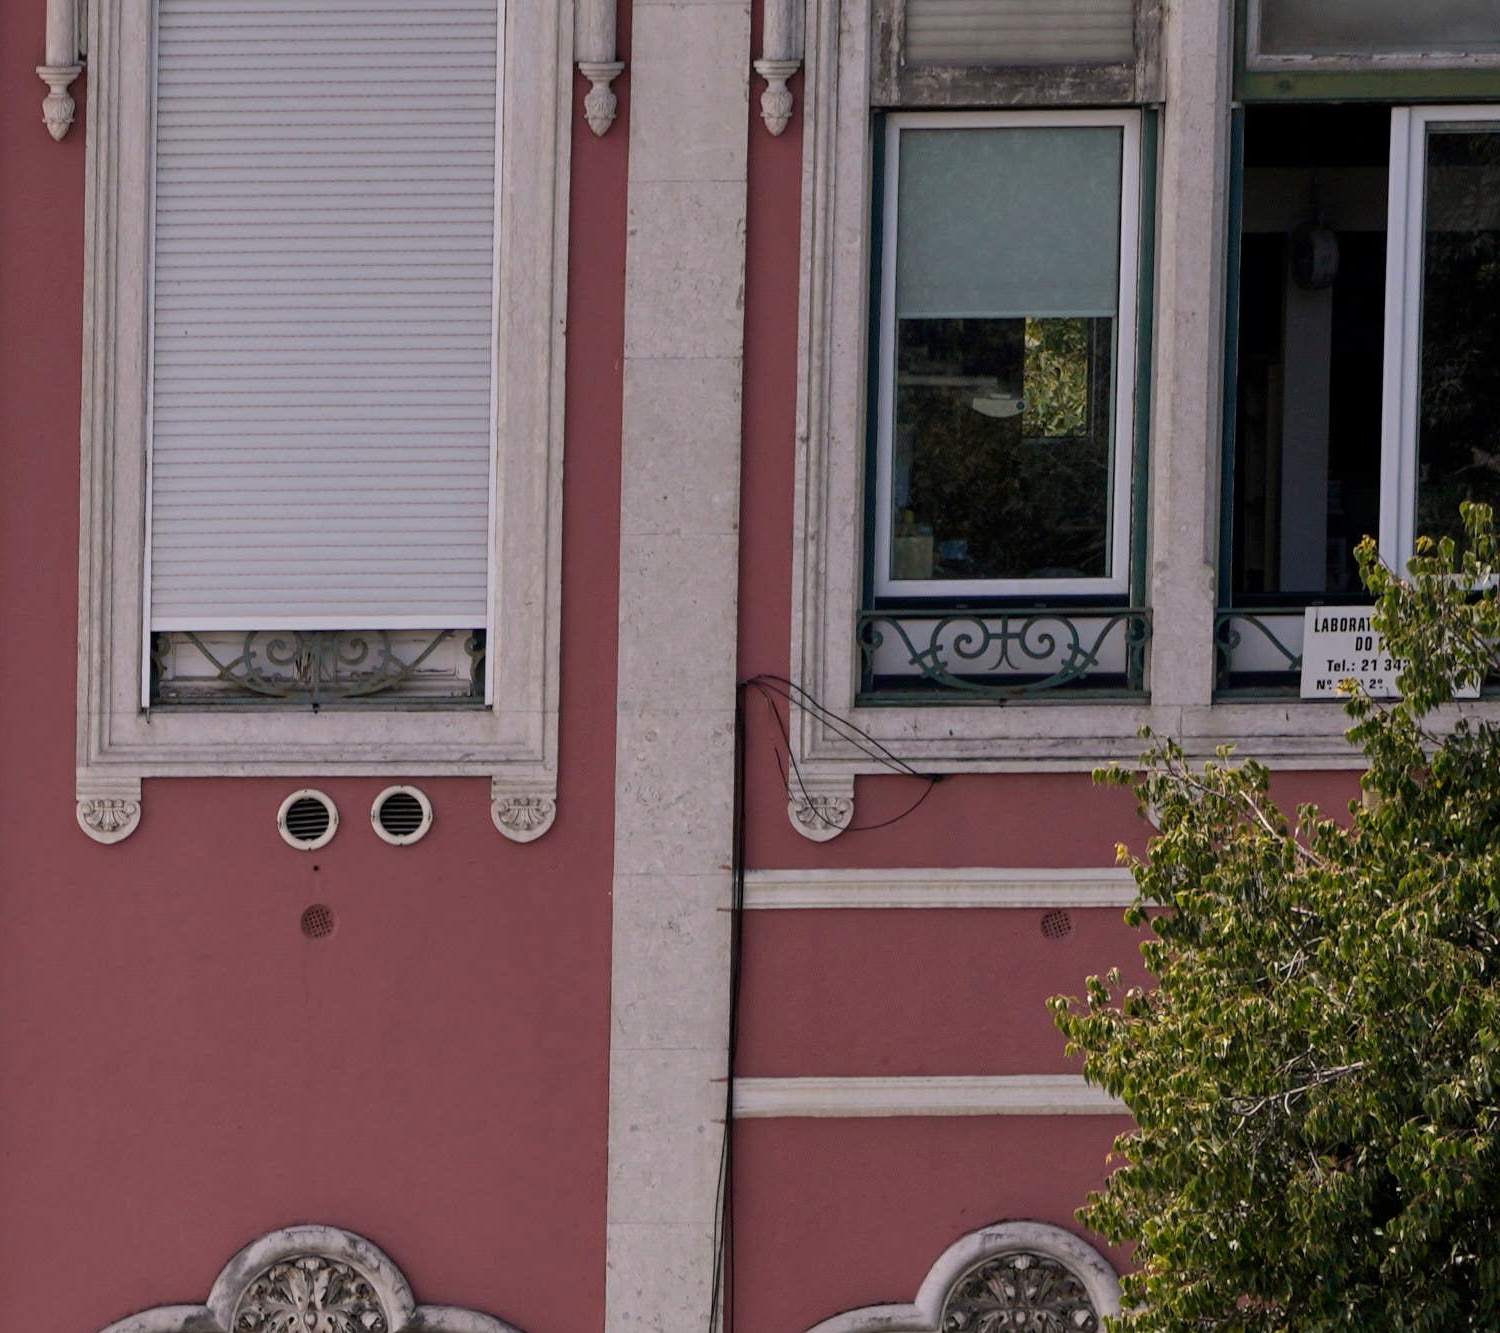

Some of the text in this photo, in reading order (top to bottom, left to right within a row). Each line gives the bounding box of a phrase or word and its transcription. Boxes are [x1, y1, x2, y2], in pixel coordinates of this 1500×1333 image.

[1314, 617, 1382, 633] LABORAT
[1355, 636, 1373, 651] DO
[1327, 659, 1356, 672] Tel.:
[1361, 659, 1378, 672] 21
